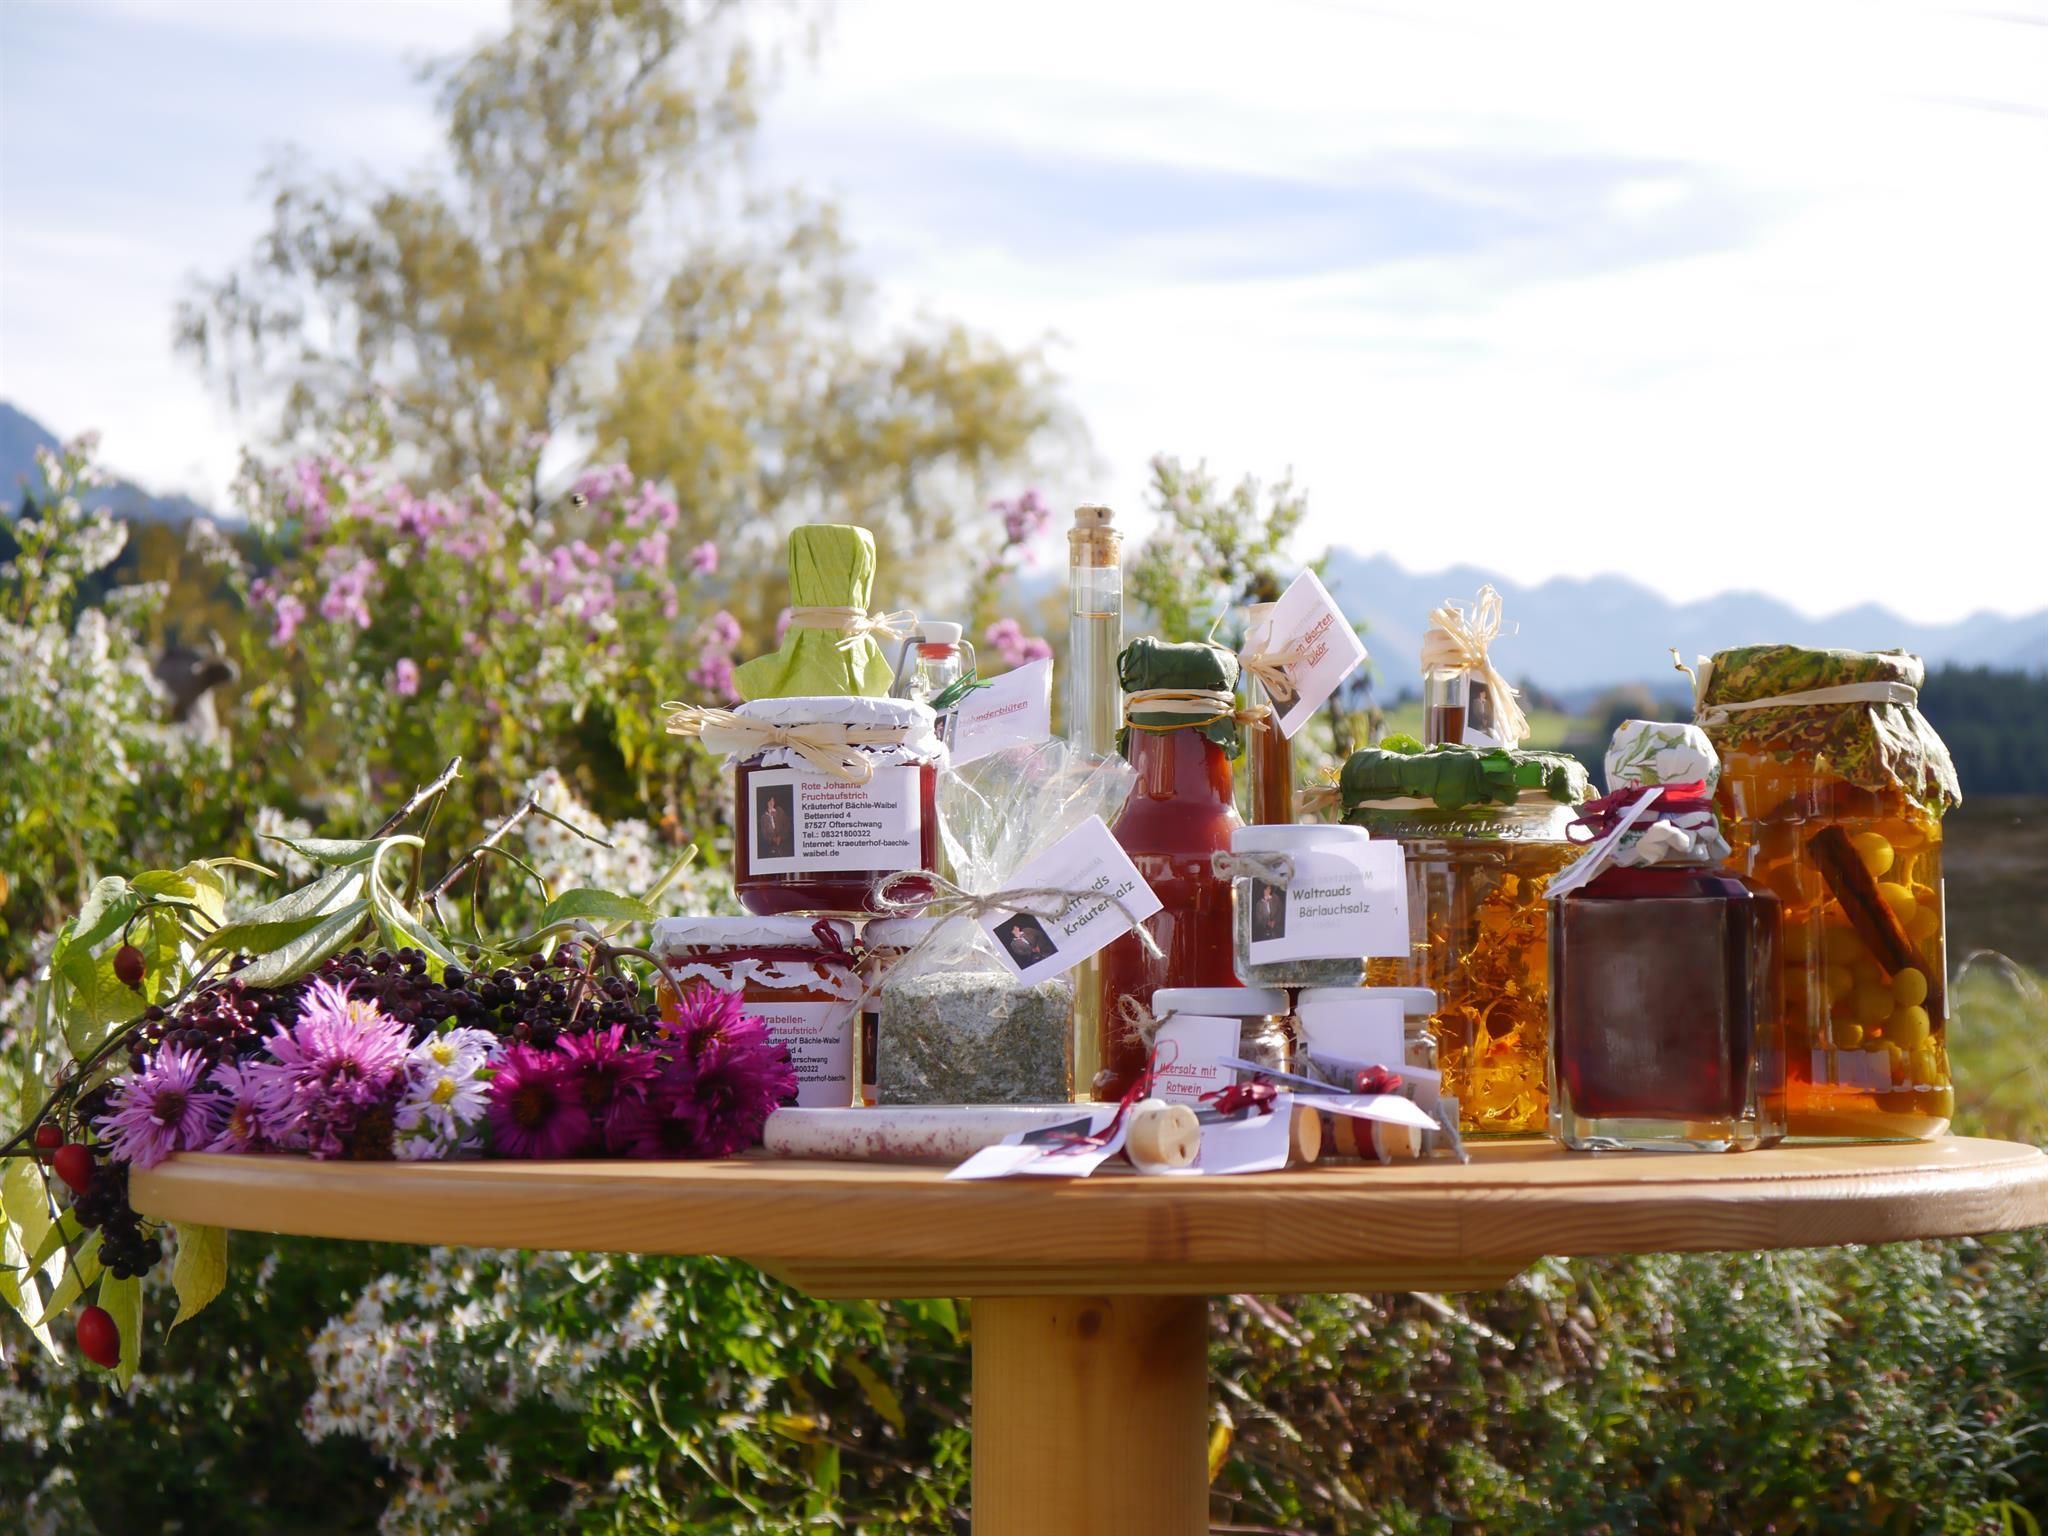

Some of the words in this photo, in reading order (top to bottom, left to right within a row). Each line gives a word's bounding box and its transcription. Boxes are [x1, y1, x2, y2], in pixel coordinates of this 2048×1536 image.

[1305, 613, 1334, 644] Garten
[801, 782, 821, 790] Rote
[801, 792, 868, 801] Fruchtaufstrich
[801, 802, 844, 810] Kräuterhof
[845, 801, 898, 809] Bächle-Waibel
[804, 812, 845, 820] Bettenried
[804, 821, 827, 829] 87527
[828, 821, 883, 829] Ofterschwang
[820, 830, 871, 838] 08321800322
[802, 840, 835, 848] Internet:
[837, 839, 910, 847] kraeuterhof-baechle-
[802, 849, 840, 858] waibel.de
[1293, 884, 1352, 900] Waltrauds
[1047, 875, 1110, 924] Wltrds
[1063, 880, 1135, 936] Kräuteralz
[1299, 901, 1370, 918] Bärlauchsalz
[754, 1015, 807, 1024] rabellen-
[773, 1027, 818, 1035] htaufstrich
[763, 1037, 798, 1045] räuterhof
[792, 1056, 828, 1064] erschwang
[1201, 1064, 1217, 1077] mit
[1166, 1081, 1202, 1094] Rotwein
